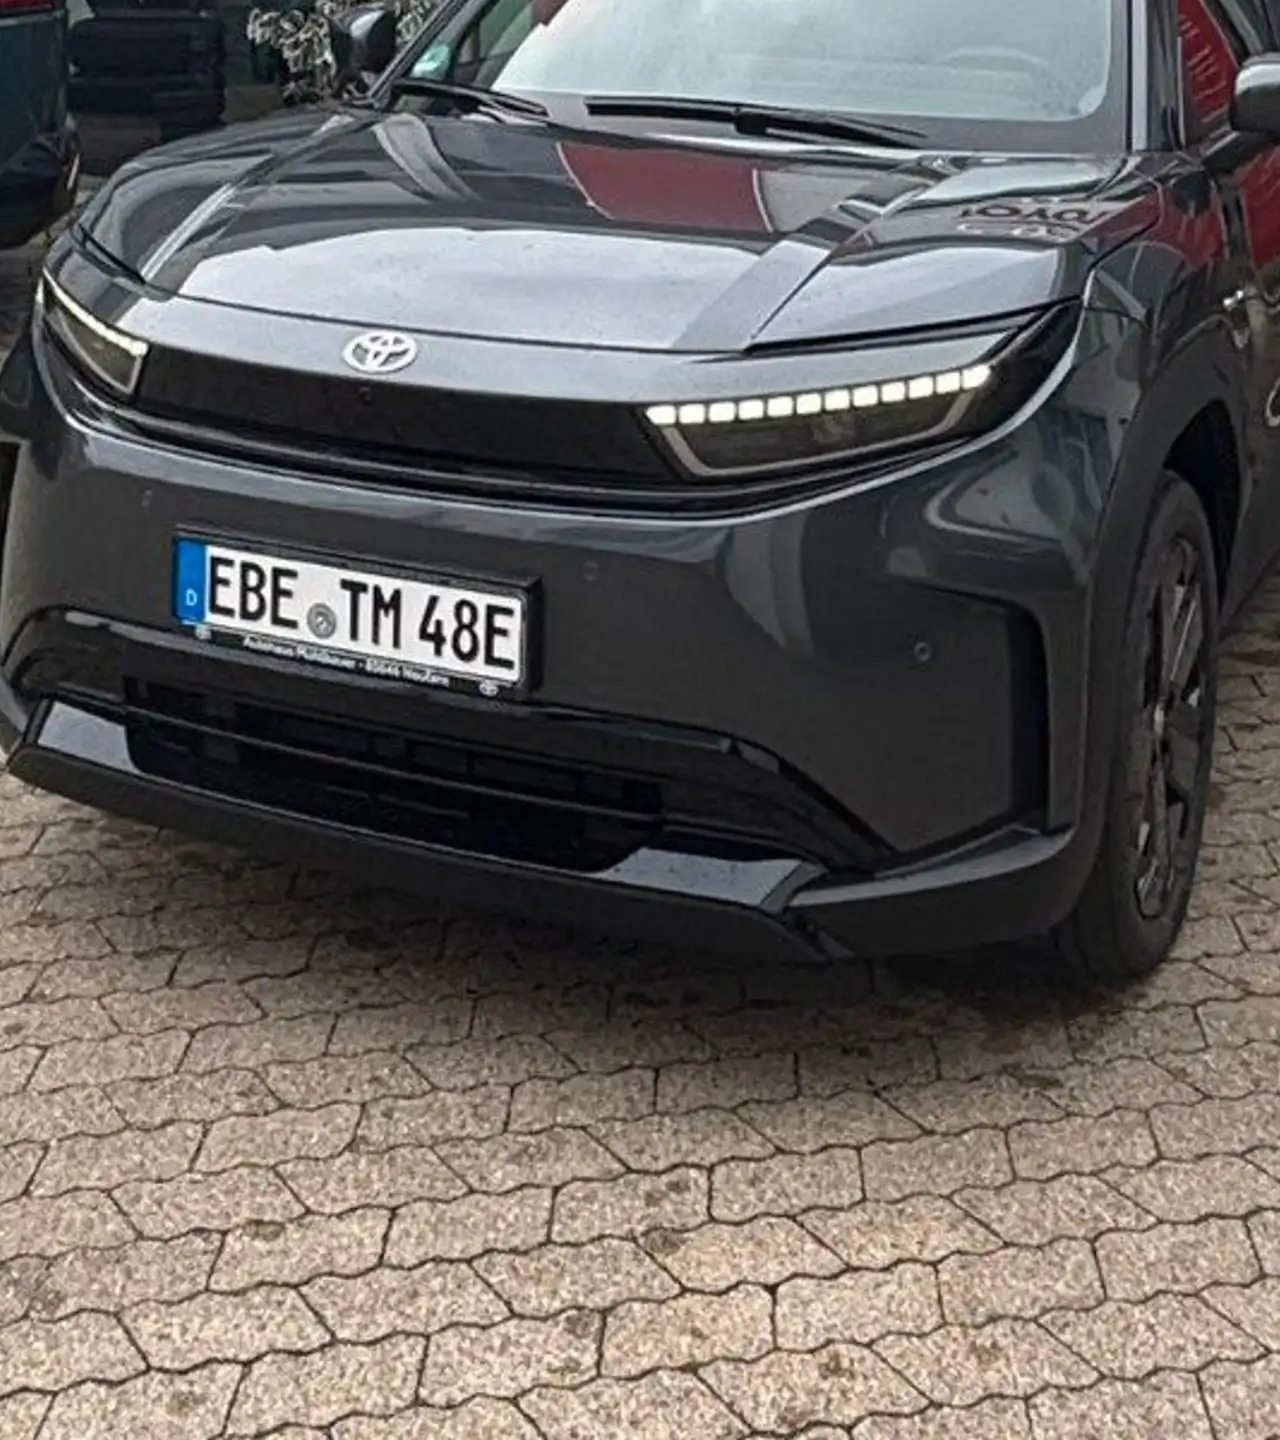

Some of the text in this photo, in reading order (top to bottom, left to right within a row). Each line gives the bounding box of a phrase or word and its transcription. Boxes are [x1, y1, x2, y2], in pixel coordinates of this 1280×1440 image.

[185, 588, 198, 607] D
[209, 556, 515, 670] EBE TM 48E
